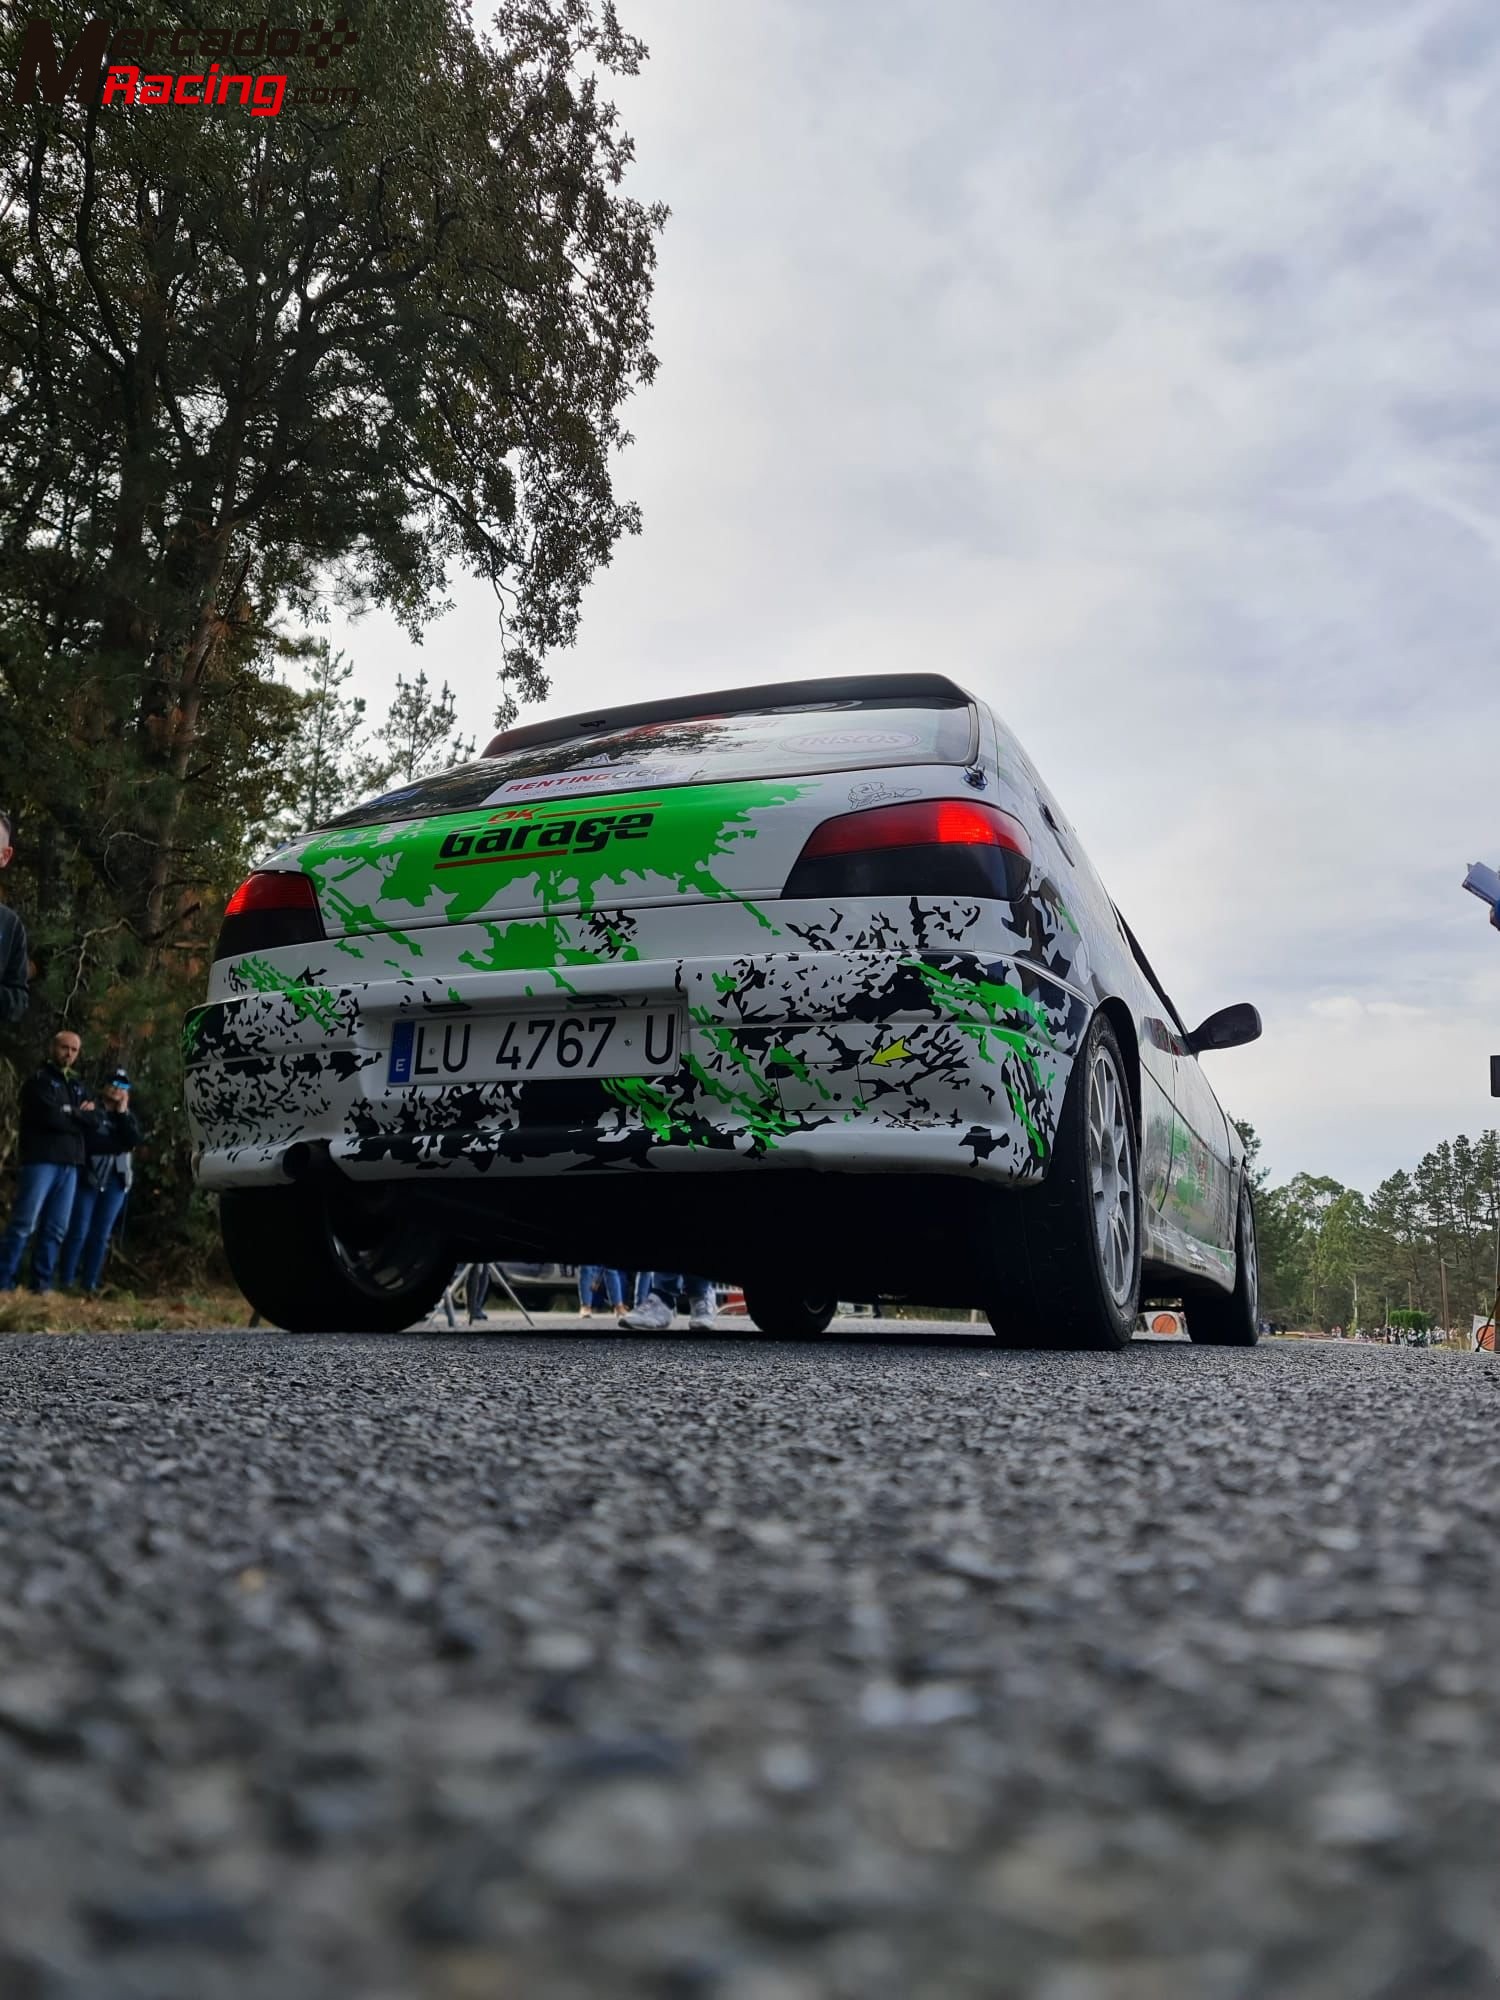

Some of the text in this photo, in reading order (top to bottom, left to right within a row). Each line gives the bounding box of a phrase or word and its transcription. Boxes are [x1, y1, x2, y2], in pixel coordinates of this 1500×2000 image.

[487, 806, 547, 824] OK
[439, 813, 655, 858] Garage
[414, 1013, 676, 1076] LU 4767 U
[395, 1058, 405, 1072] E
